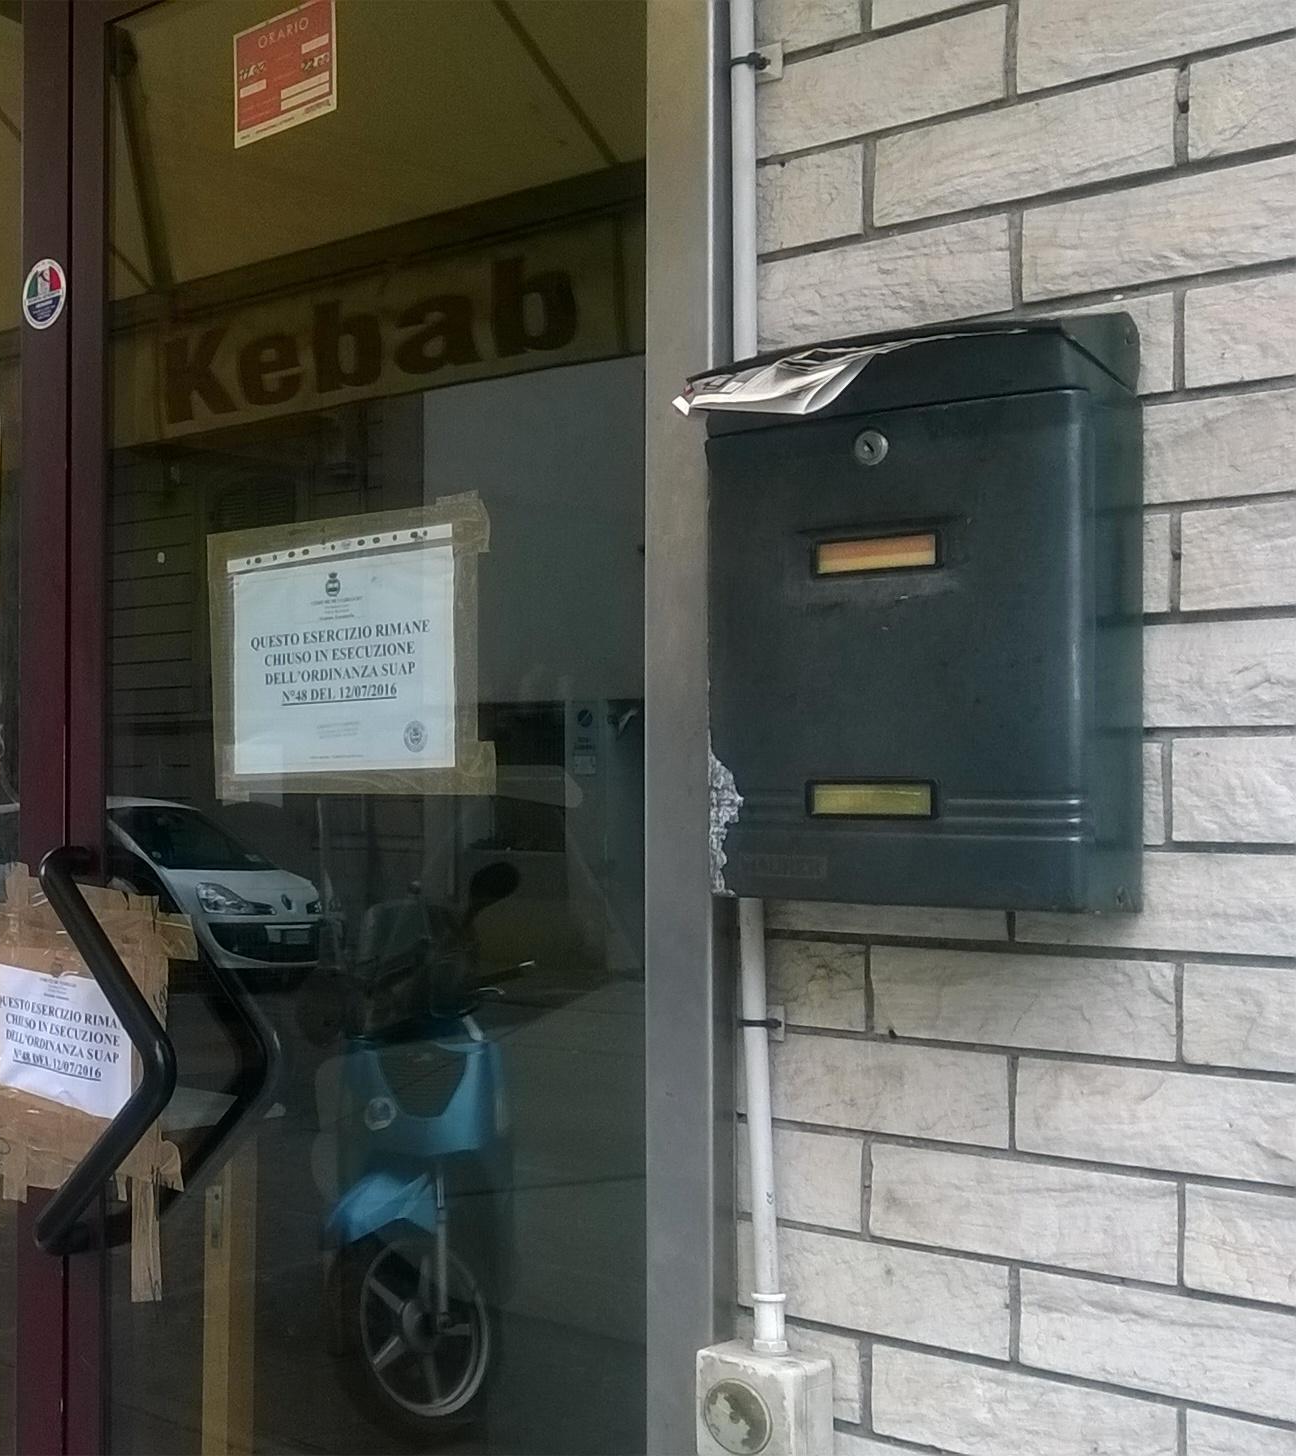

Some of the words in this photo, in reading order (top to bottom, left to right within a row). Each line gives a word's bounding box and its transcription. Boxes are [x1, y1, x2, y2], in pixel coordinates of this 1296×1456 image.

[258, 17, 309, 49] ORARIO
[164, 254, 579, 426] Kebab
[250, 632, 300, 651] QUESTO
[303, 624, 373, 645] ESERCIZIO
[375, 618, 431, 638] RIMANE
[264, 650, 312, 668] CHIUSO
[314, 647, 329, 663] IN
[331, 640, 416, 662] ESECUZIONE
[264, 664, 378, 686] DELL'ORDINANZA
[380, 660, 416, 678] SUAP
[281, 688, 308, 703] N°48
[310, 686, 337, 702] DEL
[339, 682, 398, 699] 12/07/2016
[5, 1012, 37, 1031] CHIUSO
[38, 1021, 48, 1032] IN
[48, 1022, 121, 1048] ESECUZIONE
[31, 1003, 82, 1023] ESERCIZIO
[84, 1012, 121, 1030] RIMA
[5, 1028, 85, 1060] DELL'ORDINANZA
[86, 1048, 120, 1065] SUAP
[54, 1057, 103, 1079] 12/07/2016
